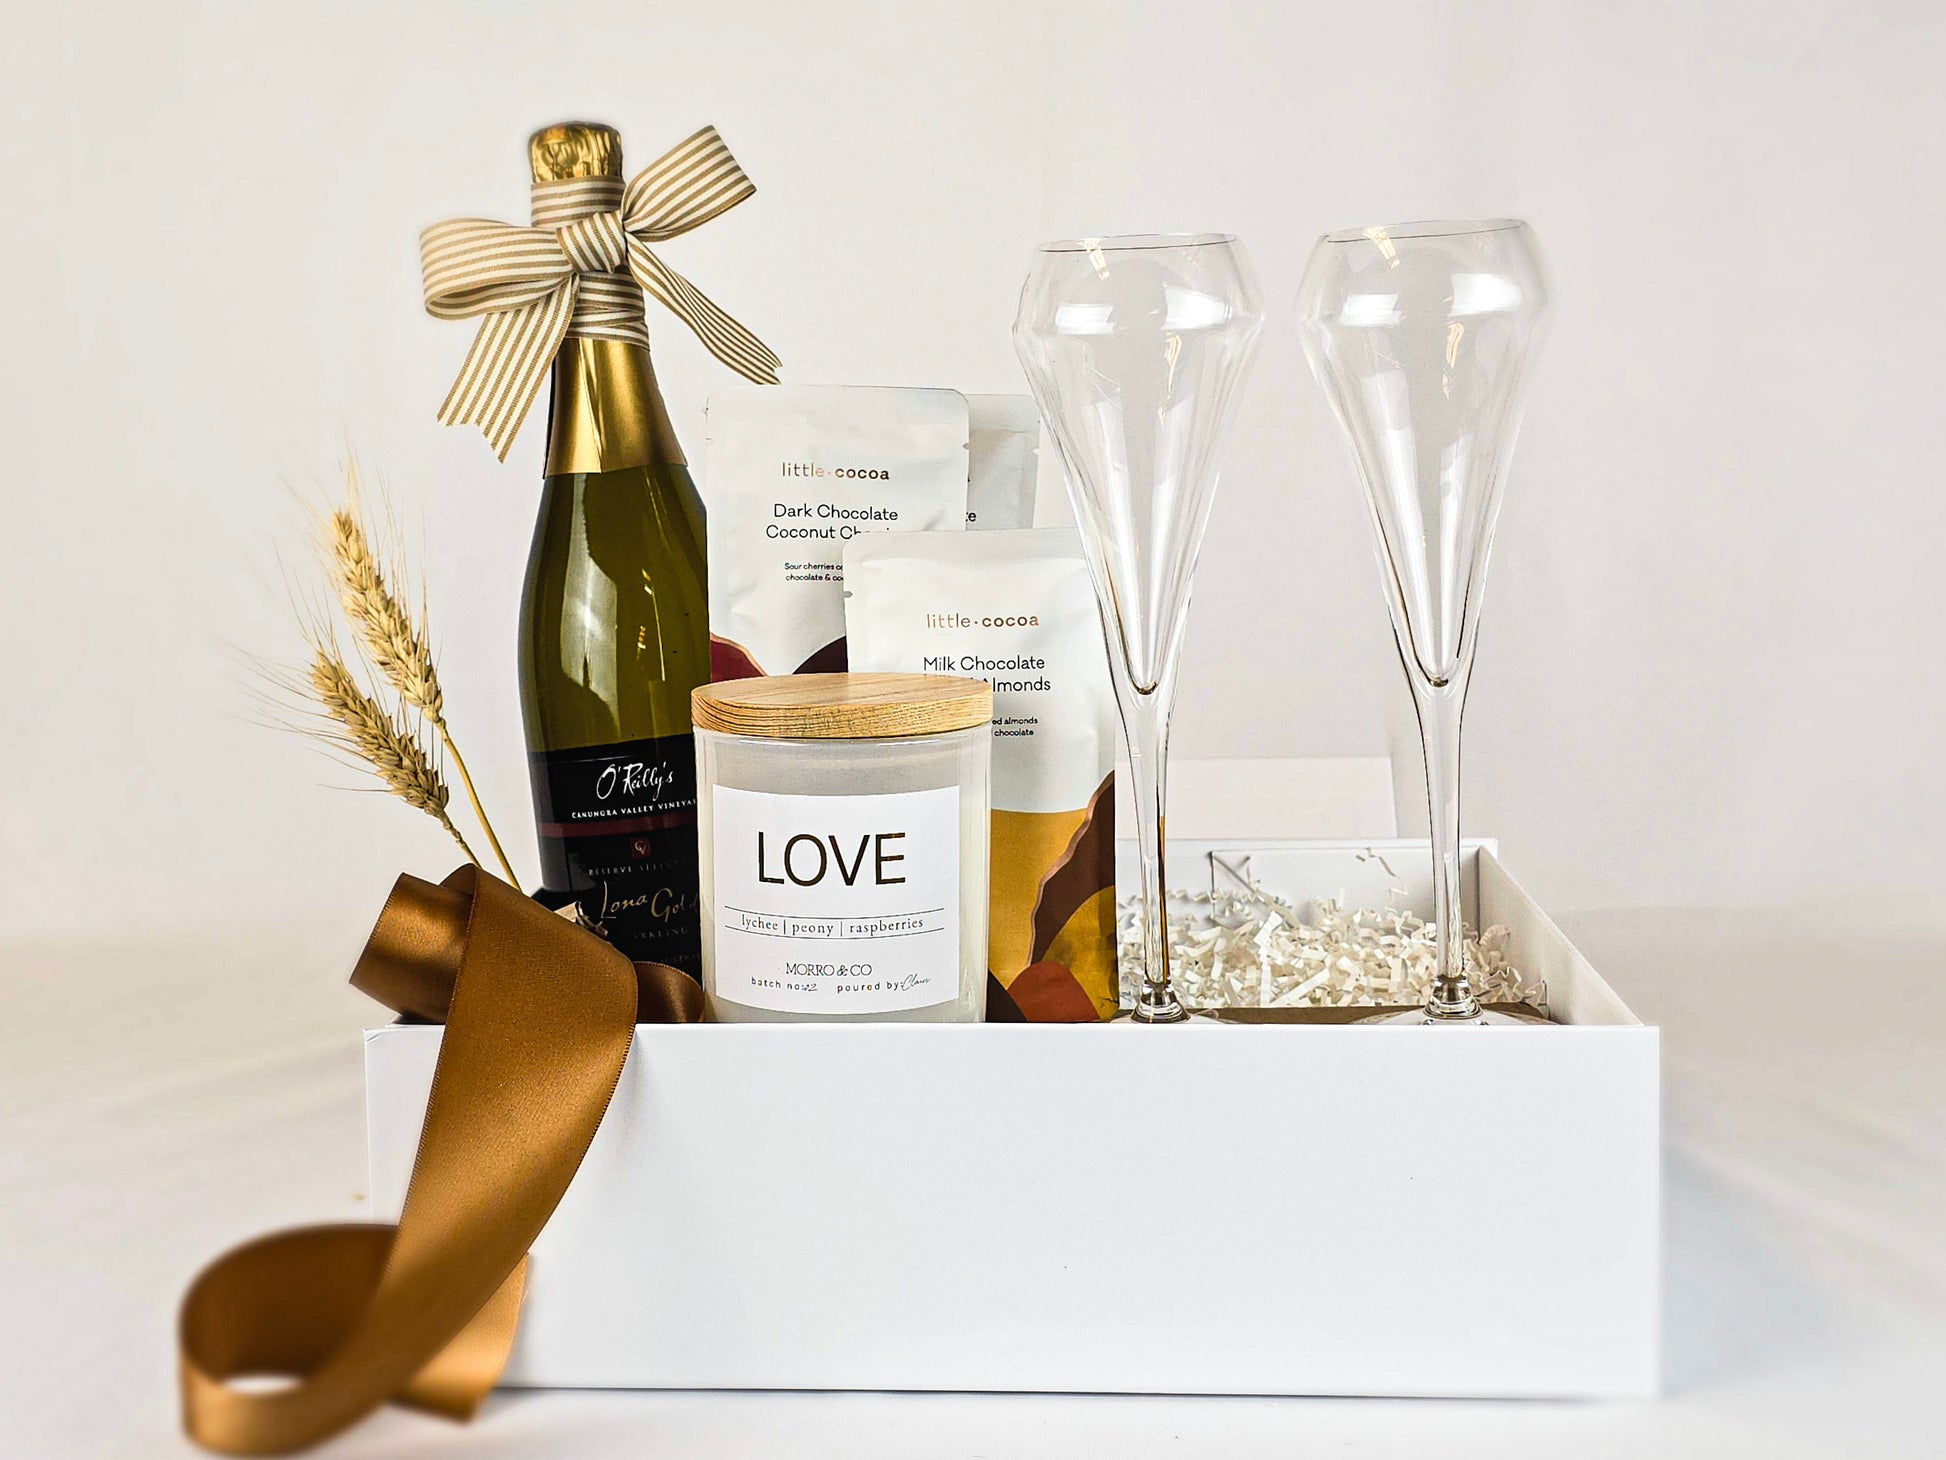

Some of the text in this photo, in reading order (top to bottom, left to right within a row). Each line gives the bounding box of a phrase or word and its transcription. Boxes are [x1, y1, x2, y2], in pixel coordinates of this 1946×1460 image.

[773, 502, 899, 521] Dark Chocolate
[765, 524, 836, 539] Coconut
[784, 562, 802, 570] Sour
[803, 562, 834, 571] cherries
[785, 573, 823, 581] chocolate
[922, 654, 1046, 671] Milk Chocolate
[1003, 716, 1038, 725] almonds
[993, 728, 1035, 737] chocolate
[596, 761, 673, 801] O'Reilly's
[620, 804, 654, 815] VALLEY
[757, 831, 906, 887] LOVE
[741, 913, 924, 938] lychee peony raspberries
[785, 962, 835, 977] MORRO
[751, 977, 781, 989] batch
[837, 981, 880, 994] poured
